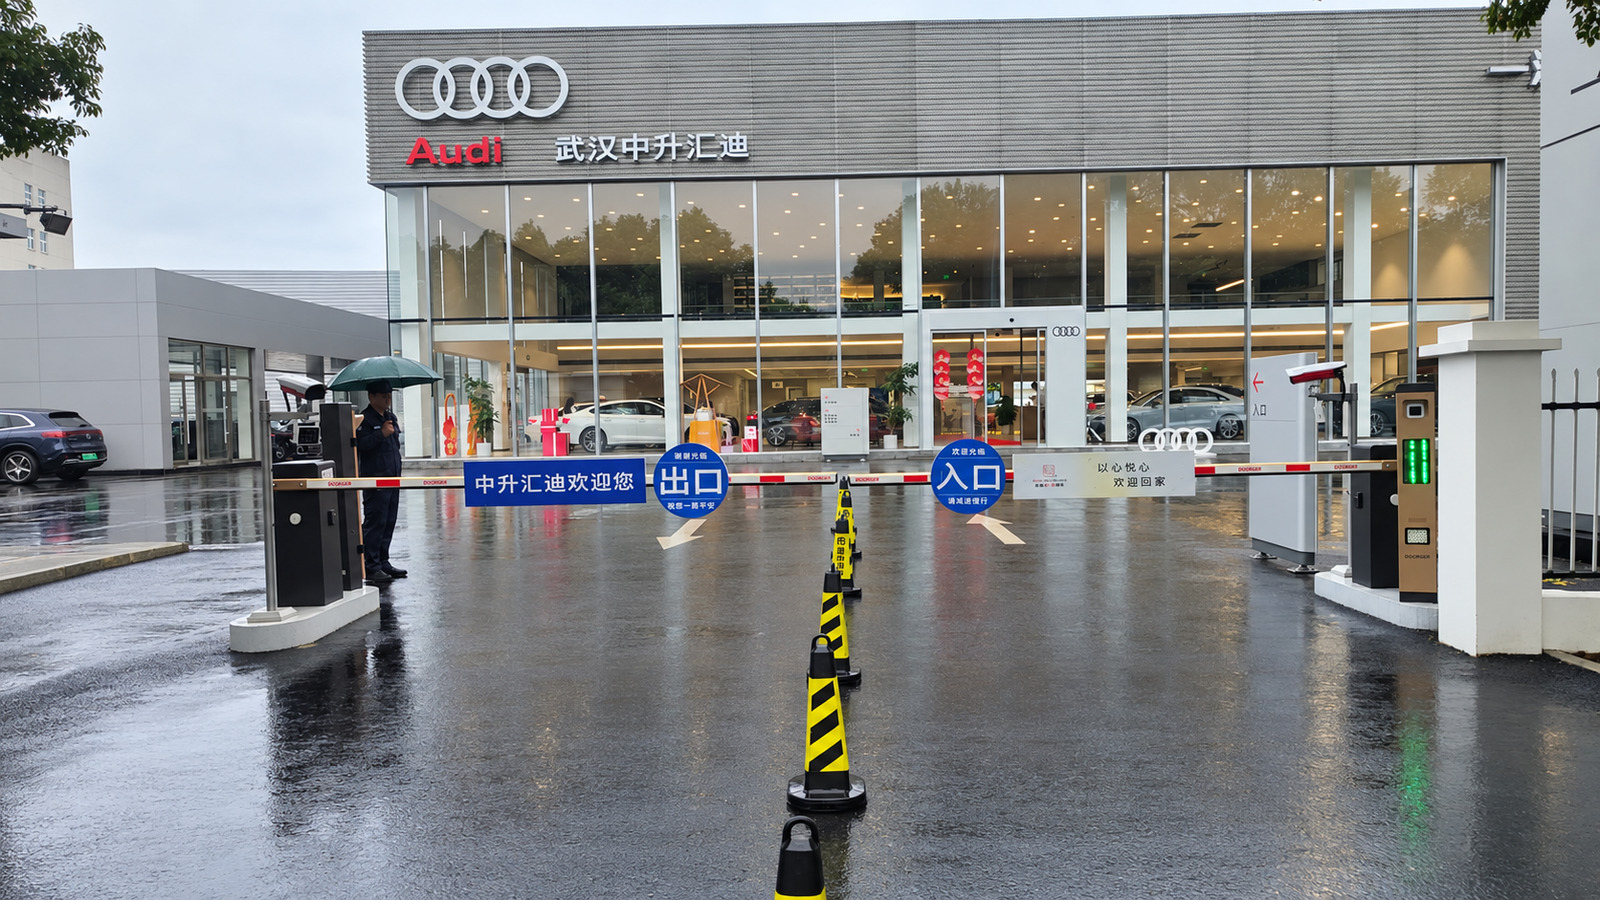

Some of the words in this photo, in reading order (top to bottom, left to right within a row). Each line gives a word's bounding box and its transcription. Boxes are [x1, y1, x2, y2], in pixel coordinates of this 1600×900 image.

[405, 136, 503, 166] Audi
[554, 132, 750, 163] 武汉中升汇迪
[1252, 403, 1267, 416] 入口
[660, 466, 722, 495] 出口
[936, 462, 1001, 491] 入口
[1097, 462, 1150, 473] 以心悦心
[475, 471, 635, 494] 中升汇迪欢迎您
[1113, 476, 1166, 488] 欢迎回家
